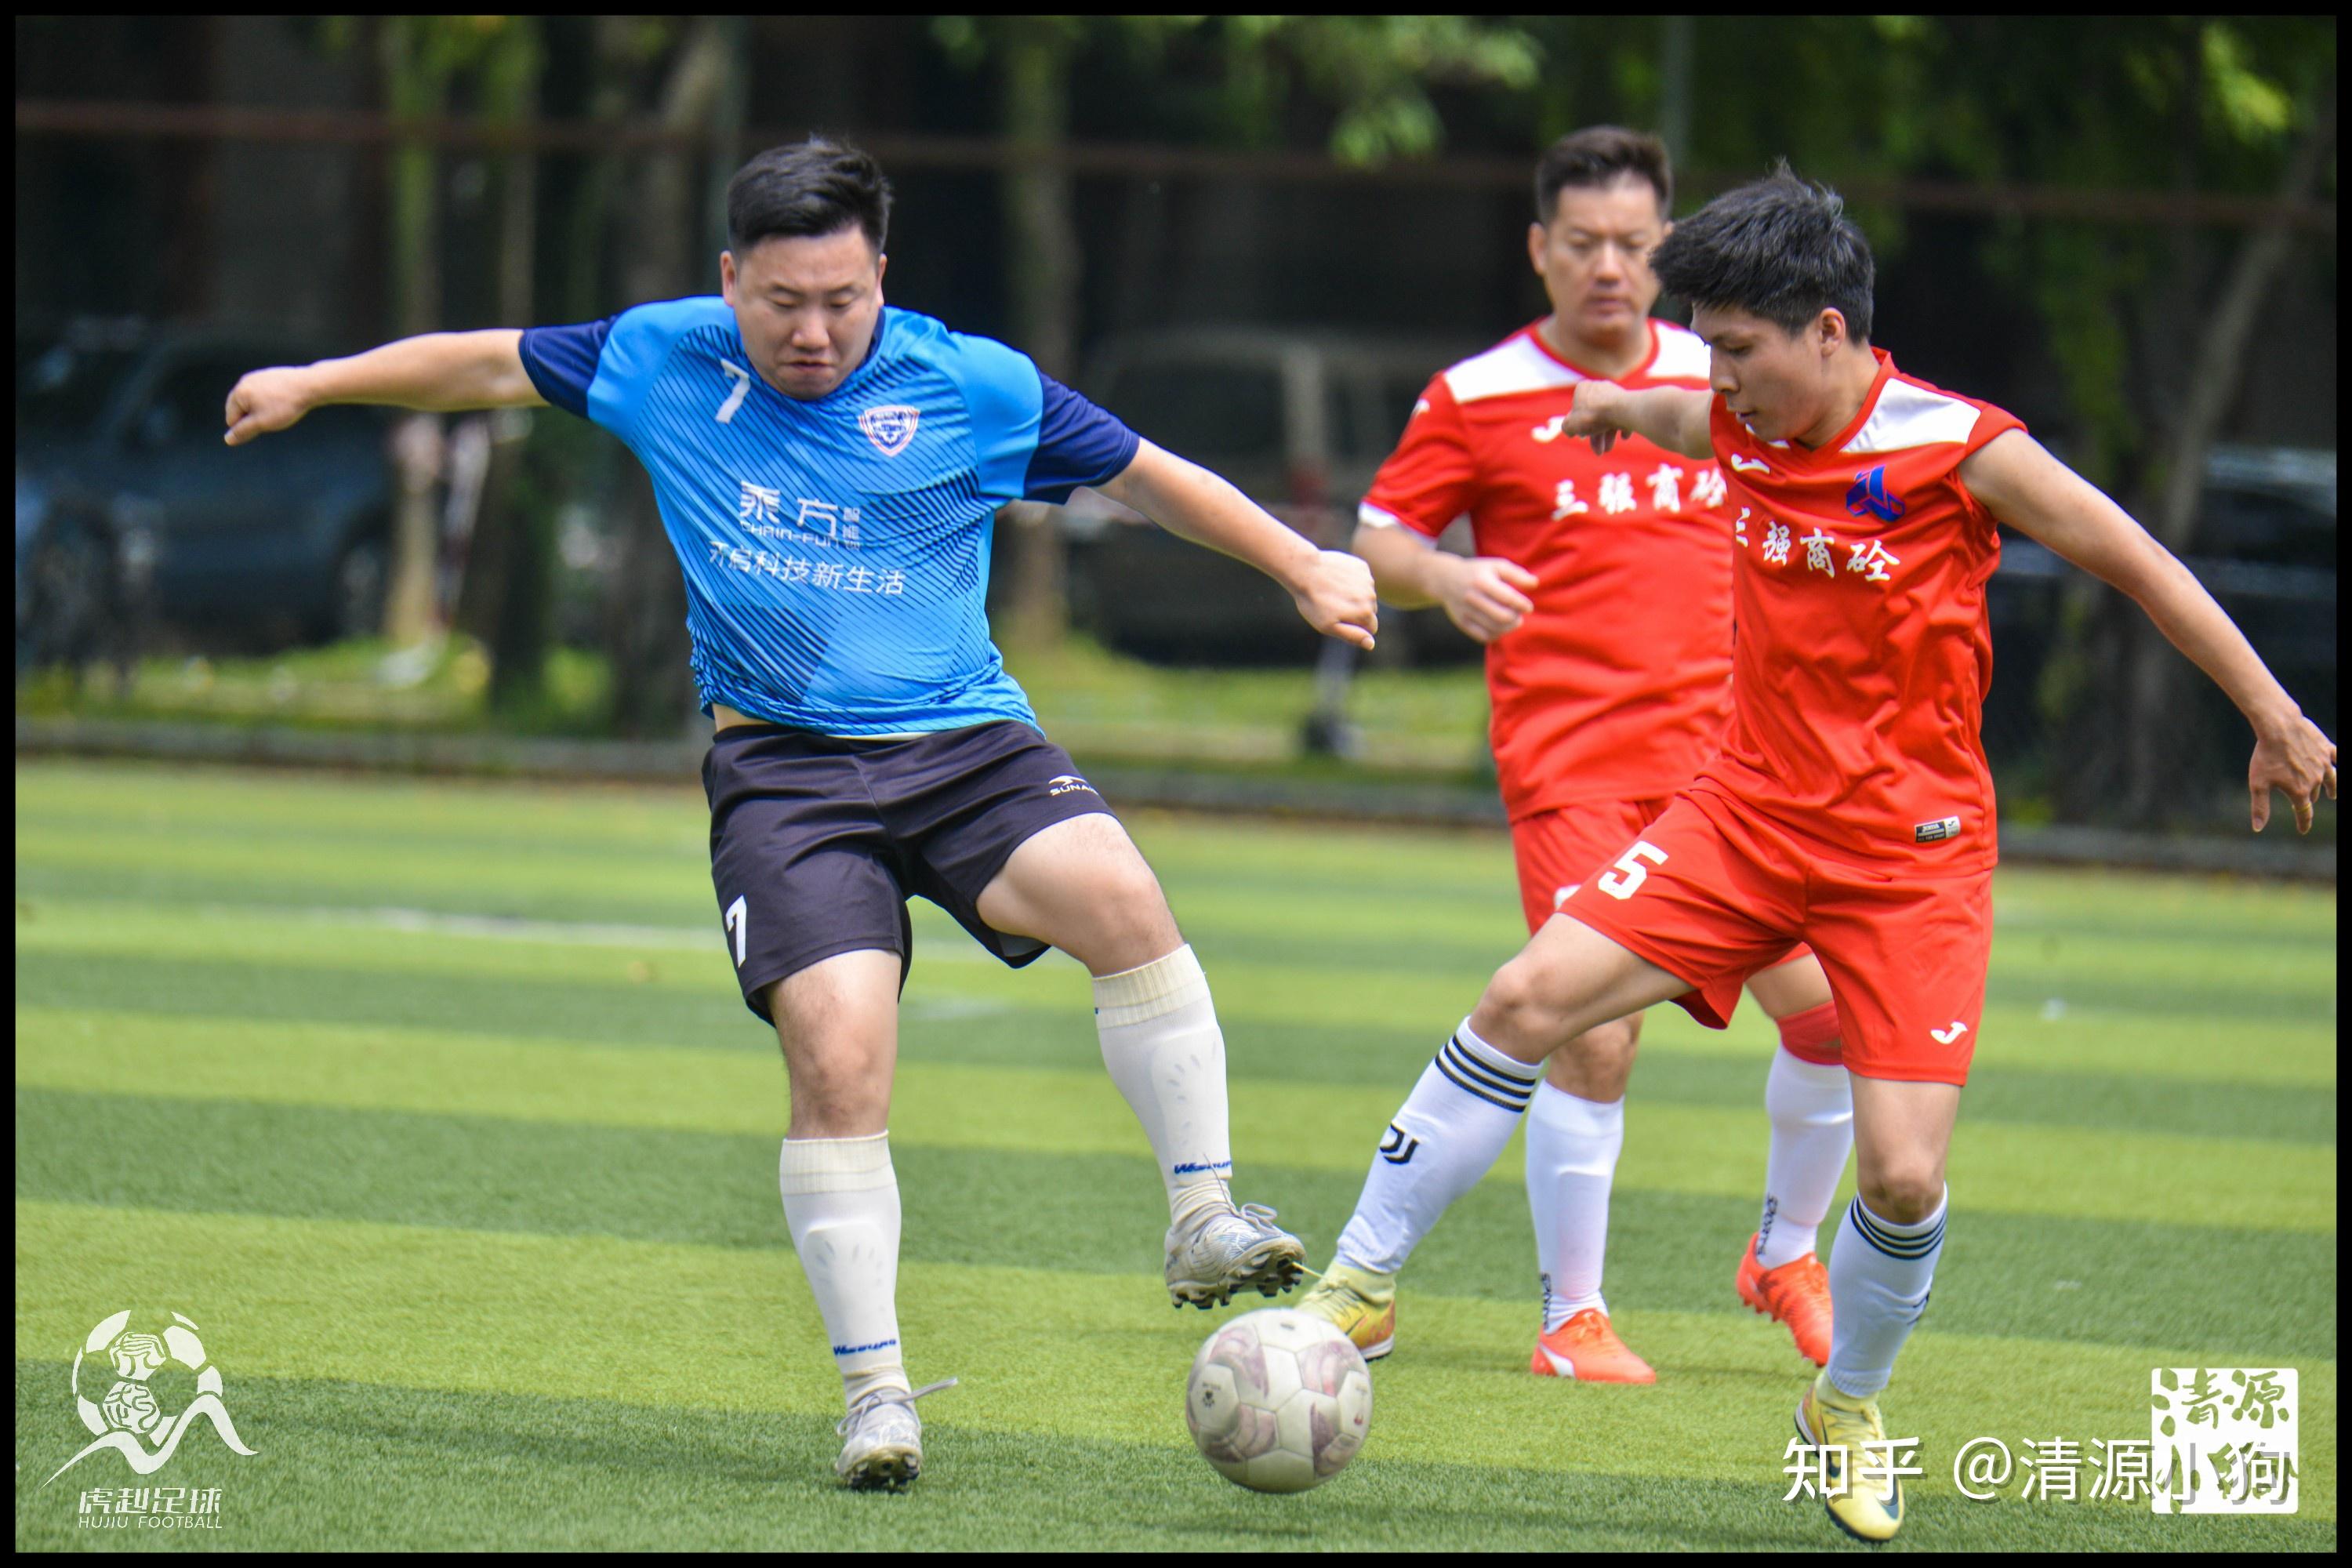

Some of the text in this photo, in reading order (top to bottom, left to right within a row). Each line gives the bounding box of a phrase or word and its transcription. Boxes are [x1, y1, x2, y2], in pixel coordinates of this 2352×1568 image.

[715, 358, 750, 423] 7
[1598, 840, 1668, 900] 5
[725, 895, 747, 968] 7
